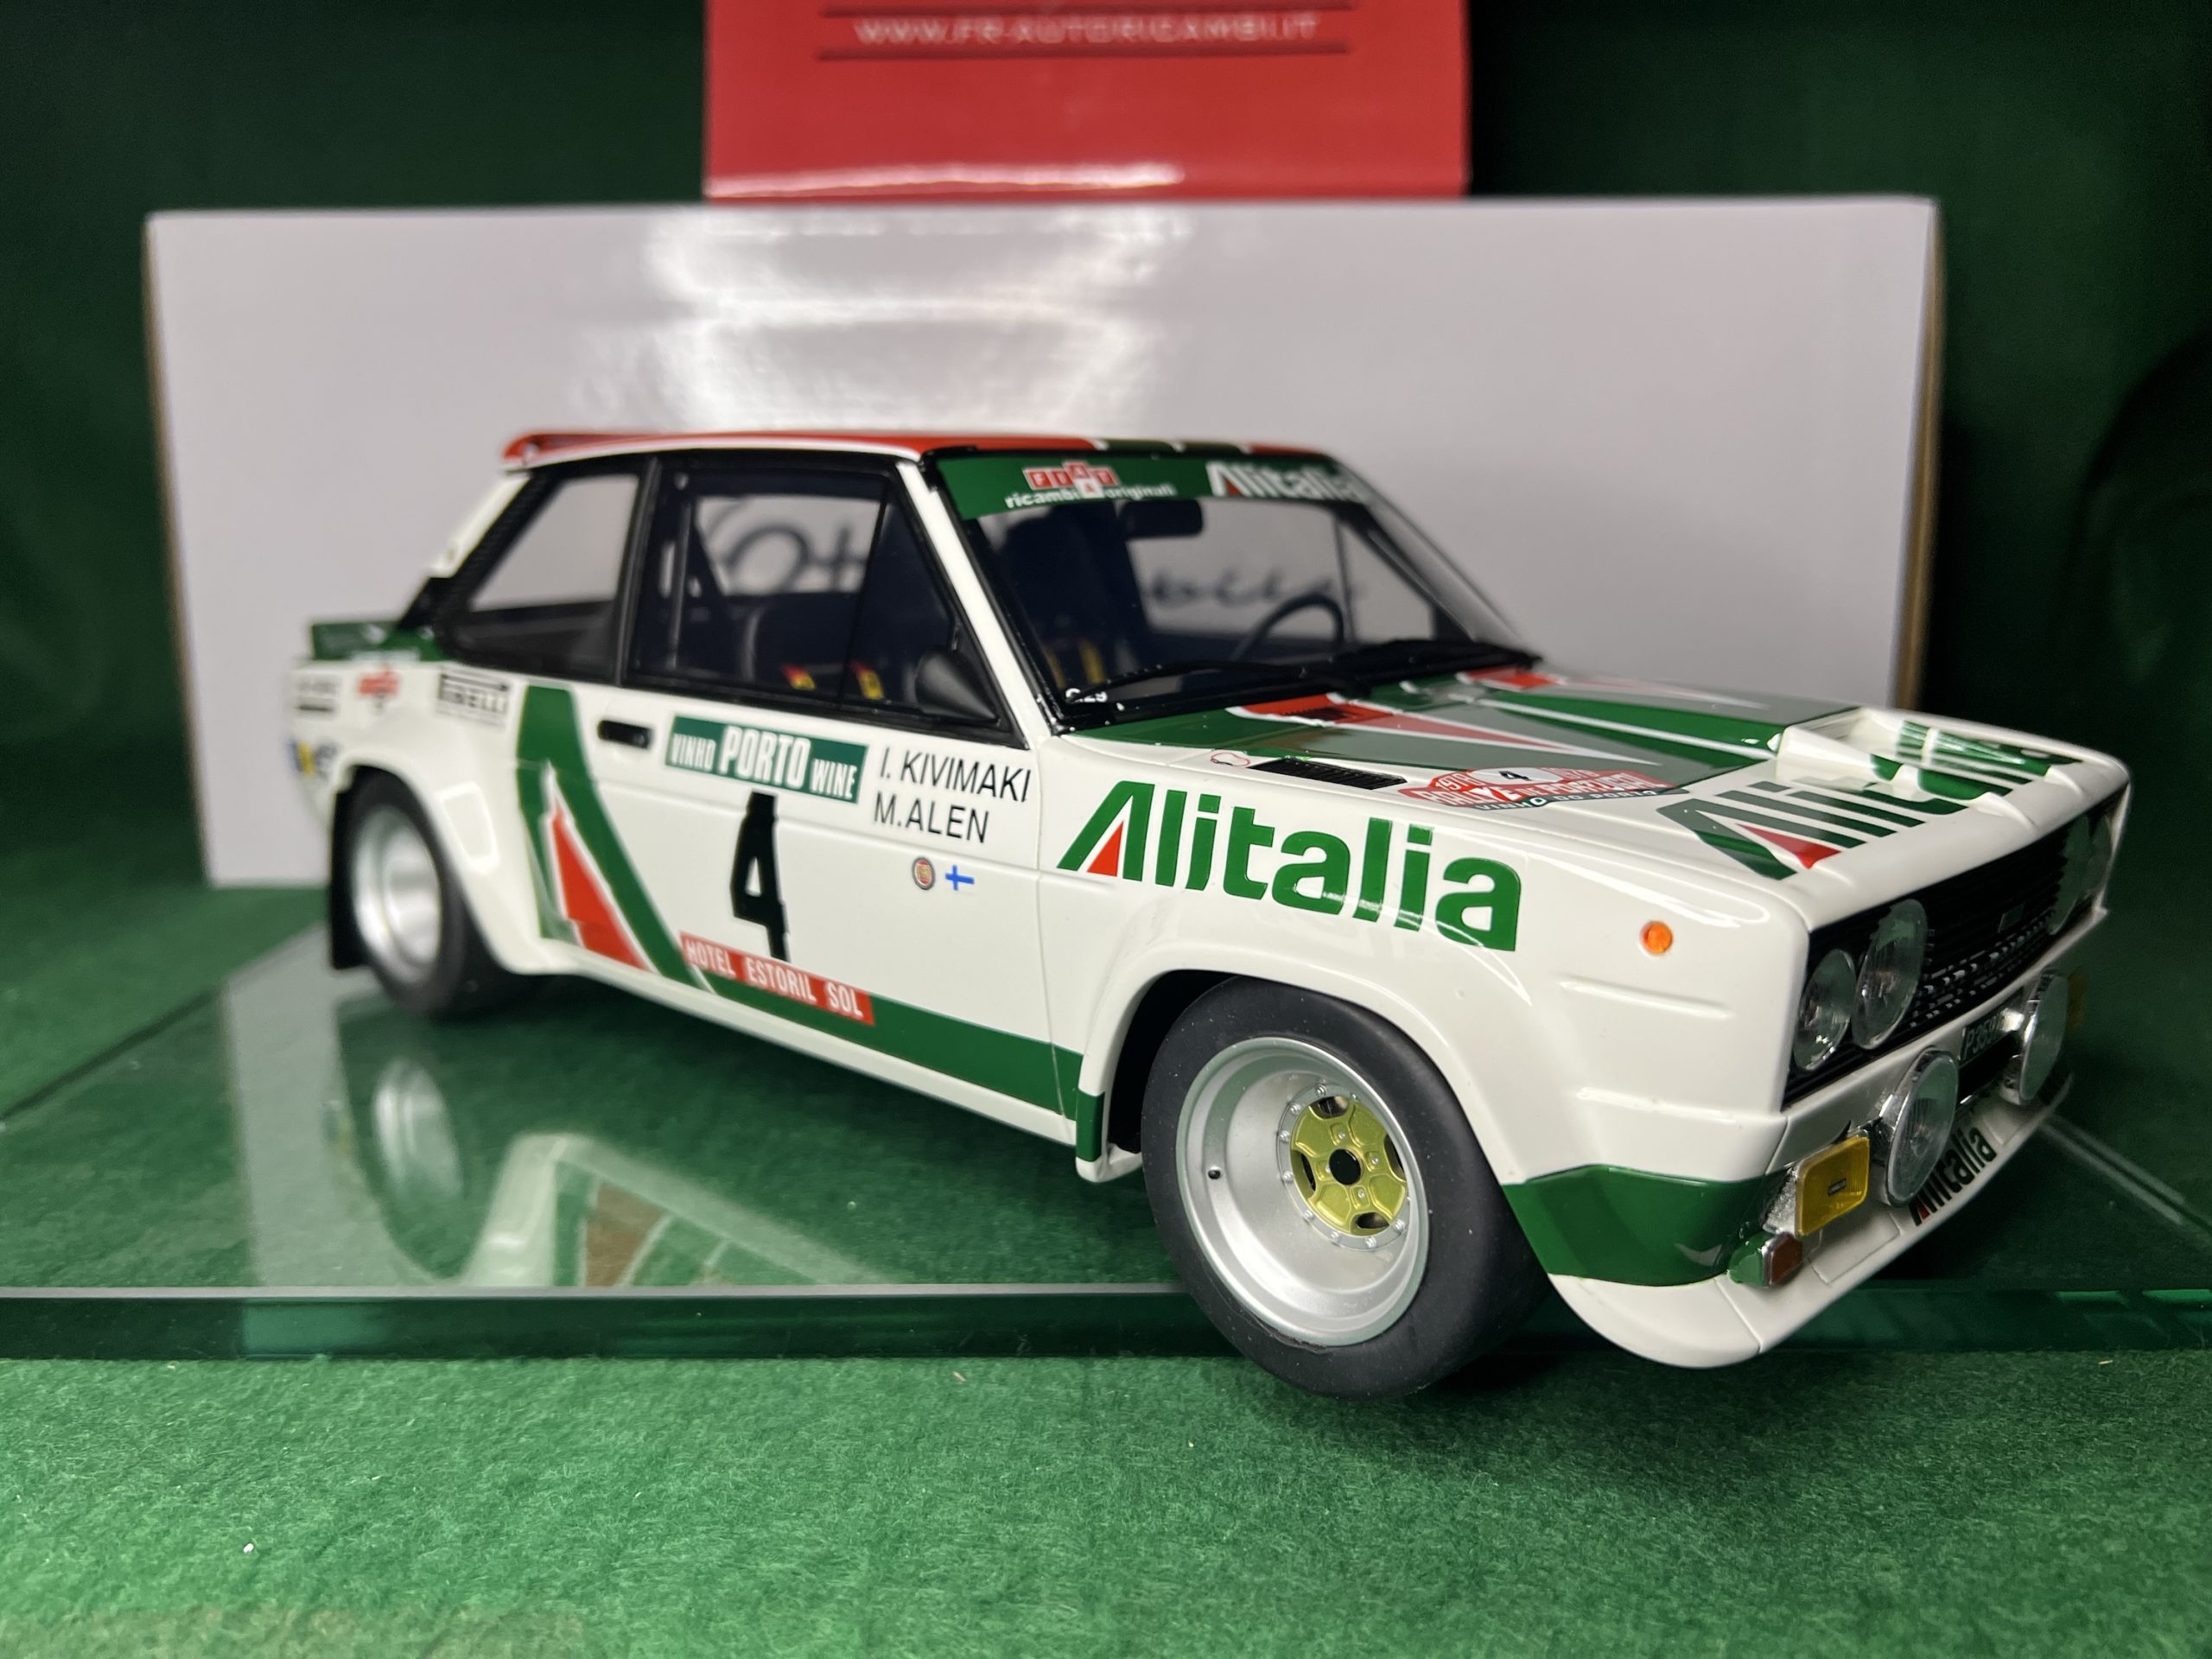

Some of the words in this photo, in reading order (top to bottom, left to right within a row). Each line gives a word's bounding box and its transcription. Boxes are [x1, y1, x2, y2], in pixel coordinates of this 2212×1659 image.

[1005, 489, 1079, 509] ricambi
[671, 734, 716, 773] VINHO
[717, 724, 811, 790] PORTO
[810, 757, 858, 800] WINE
[901, 750, 1031, 803] KIVIMAKI
[1497, 770, 1532, 781] 4
[874, 791, 989, 843] M.ALEN
[1474, 797, 1547, 810] VINHO
[730, 791, 791, 963] 4
[1056, 780, 1522, 952] Alitalia
[685, 937, 736, 978] HOTEL
[741, 956, 817, 1003] ESTORIL
[823, 980, 864, 1020] SOL
